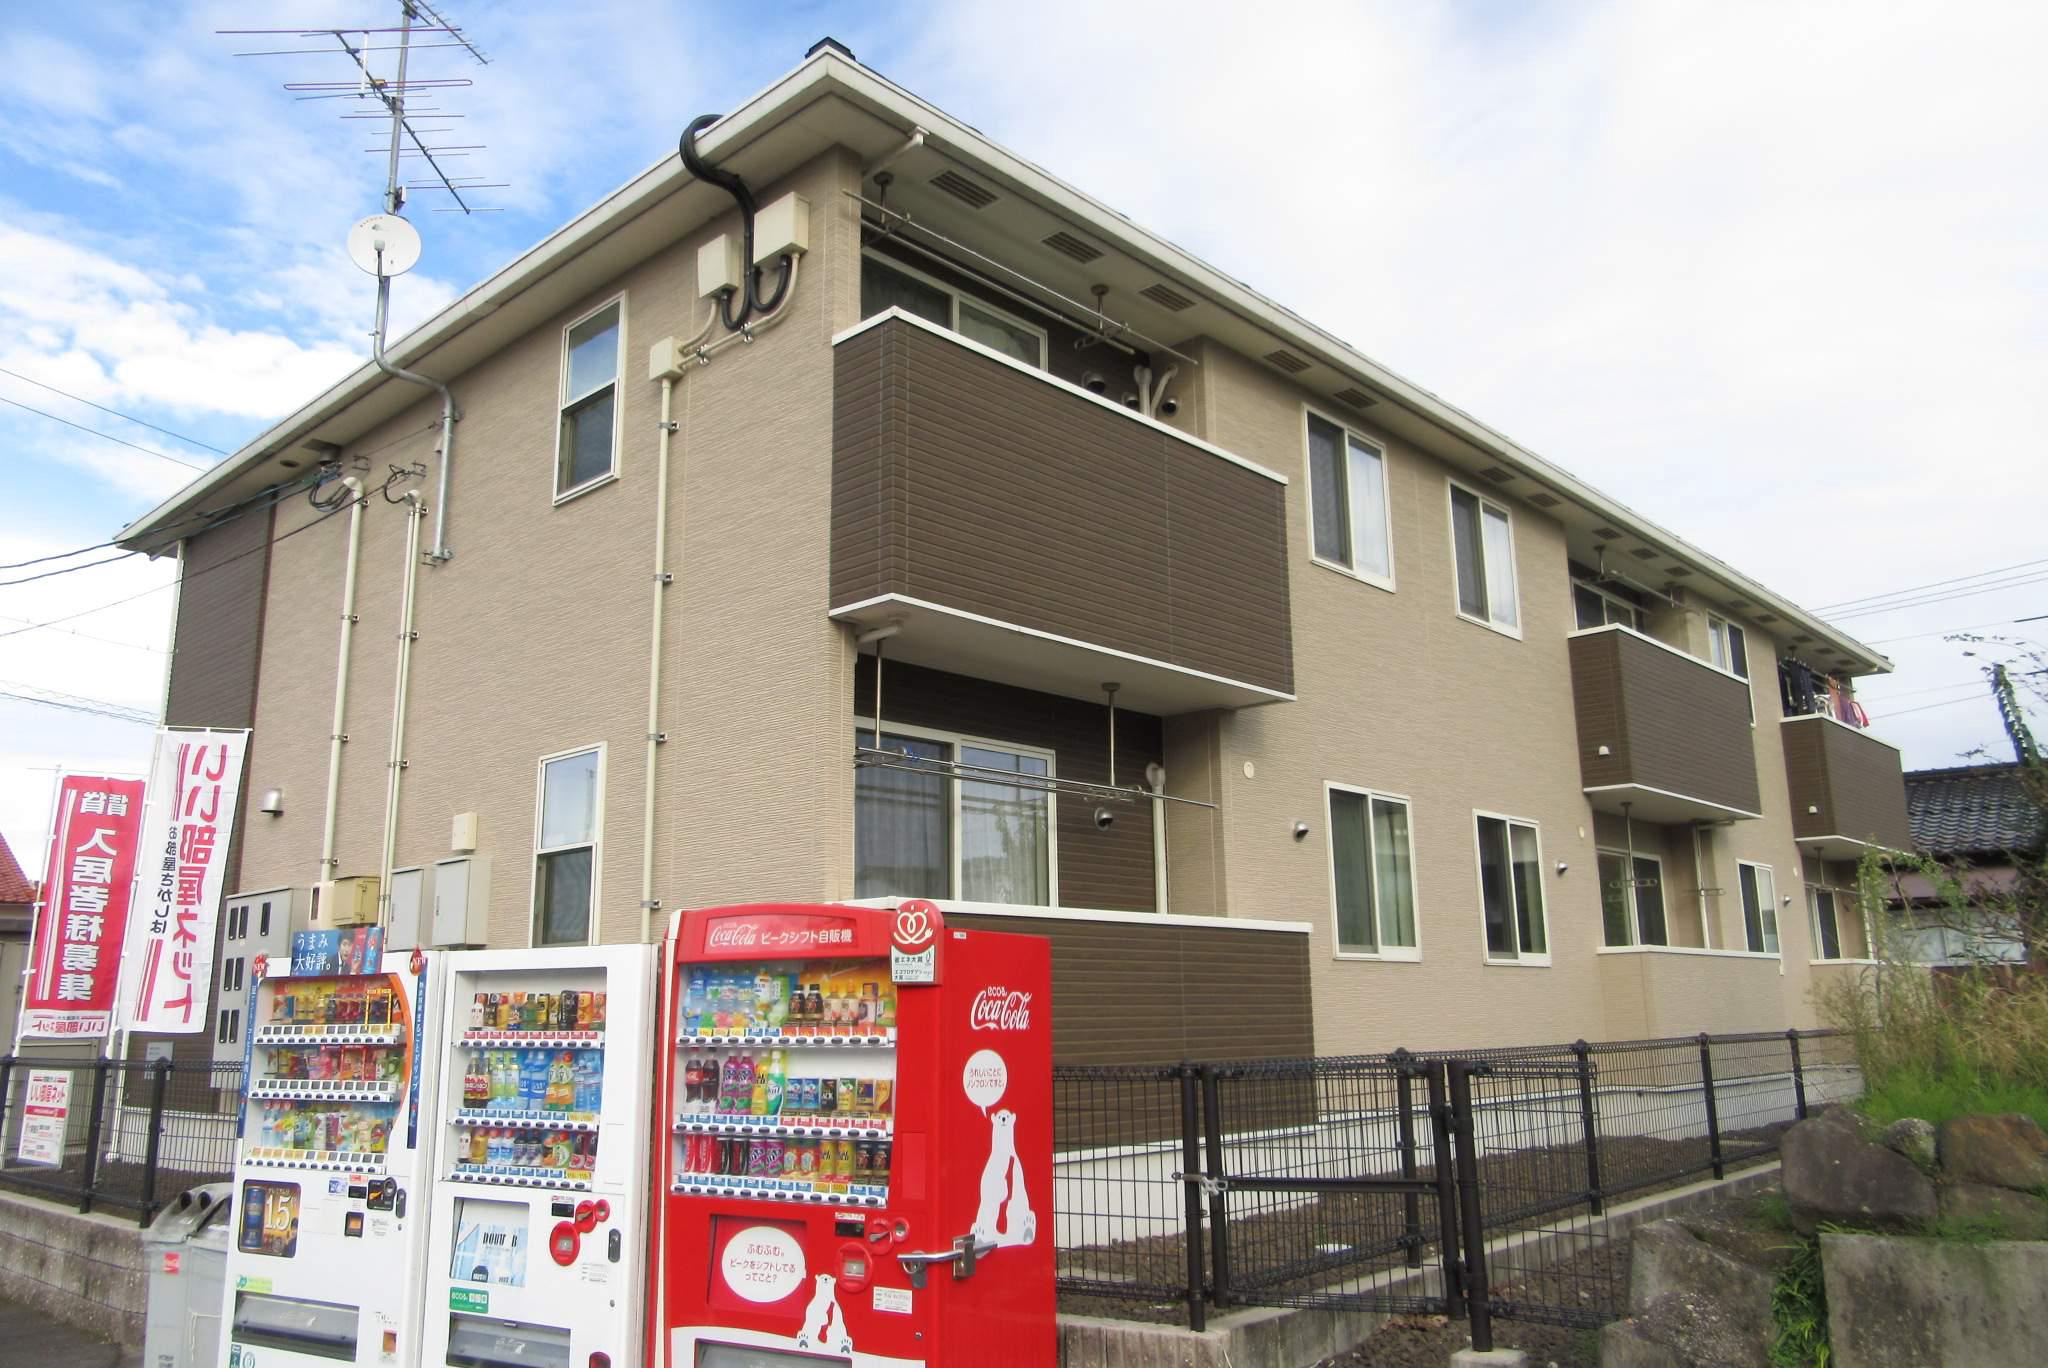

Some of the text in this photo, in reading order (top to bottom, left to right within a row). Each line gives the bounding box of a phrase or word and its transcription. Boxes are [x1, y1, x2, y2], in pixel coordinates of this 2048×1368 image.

[297, 933, 329, 951] うまみ
[761, 929, 853, 945] ピークシフト自販機
[294, 951, 331, 971] 大好評。
[412, 956, 428, 965] NEW
